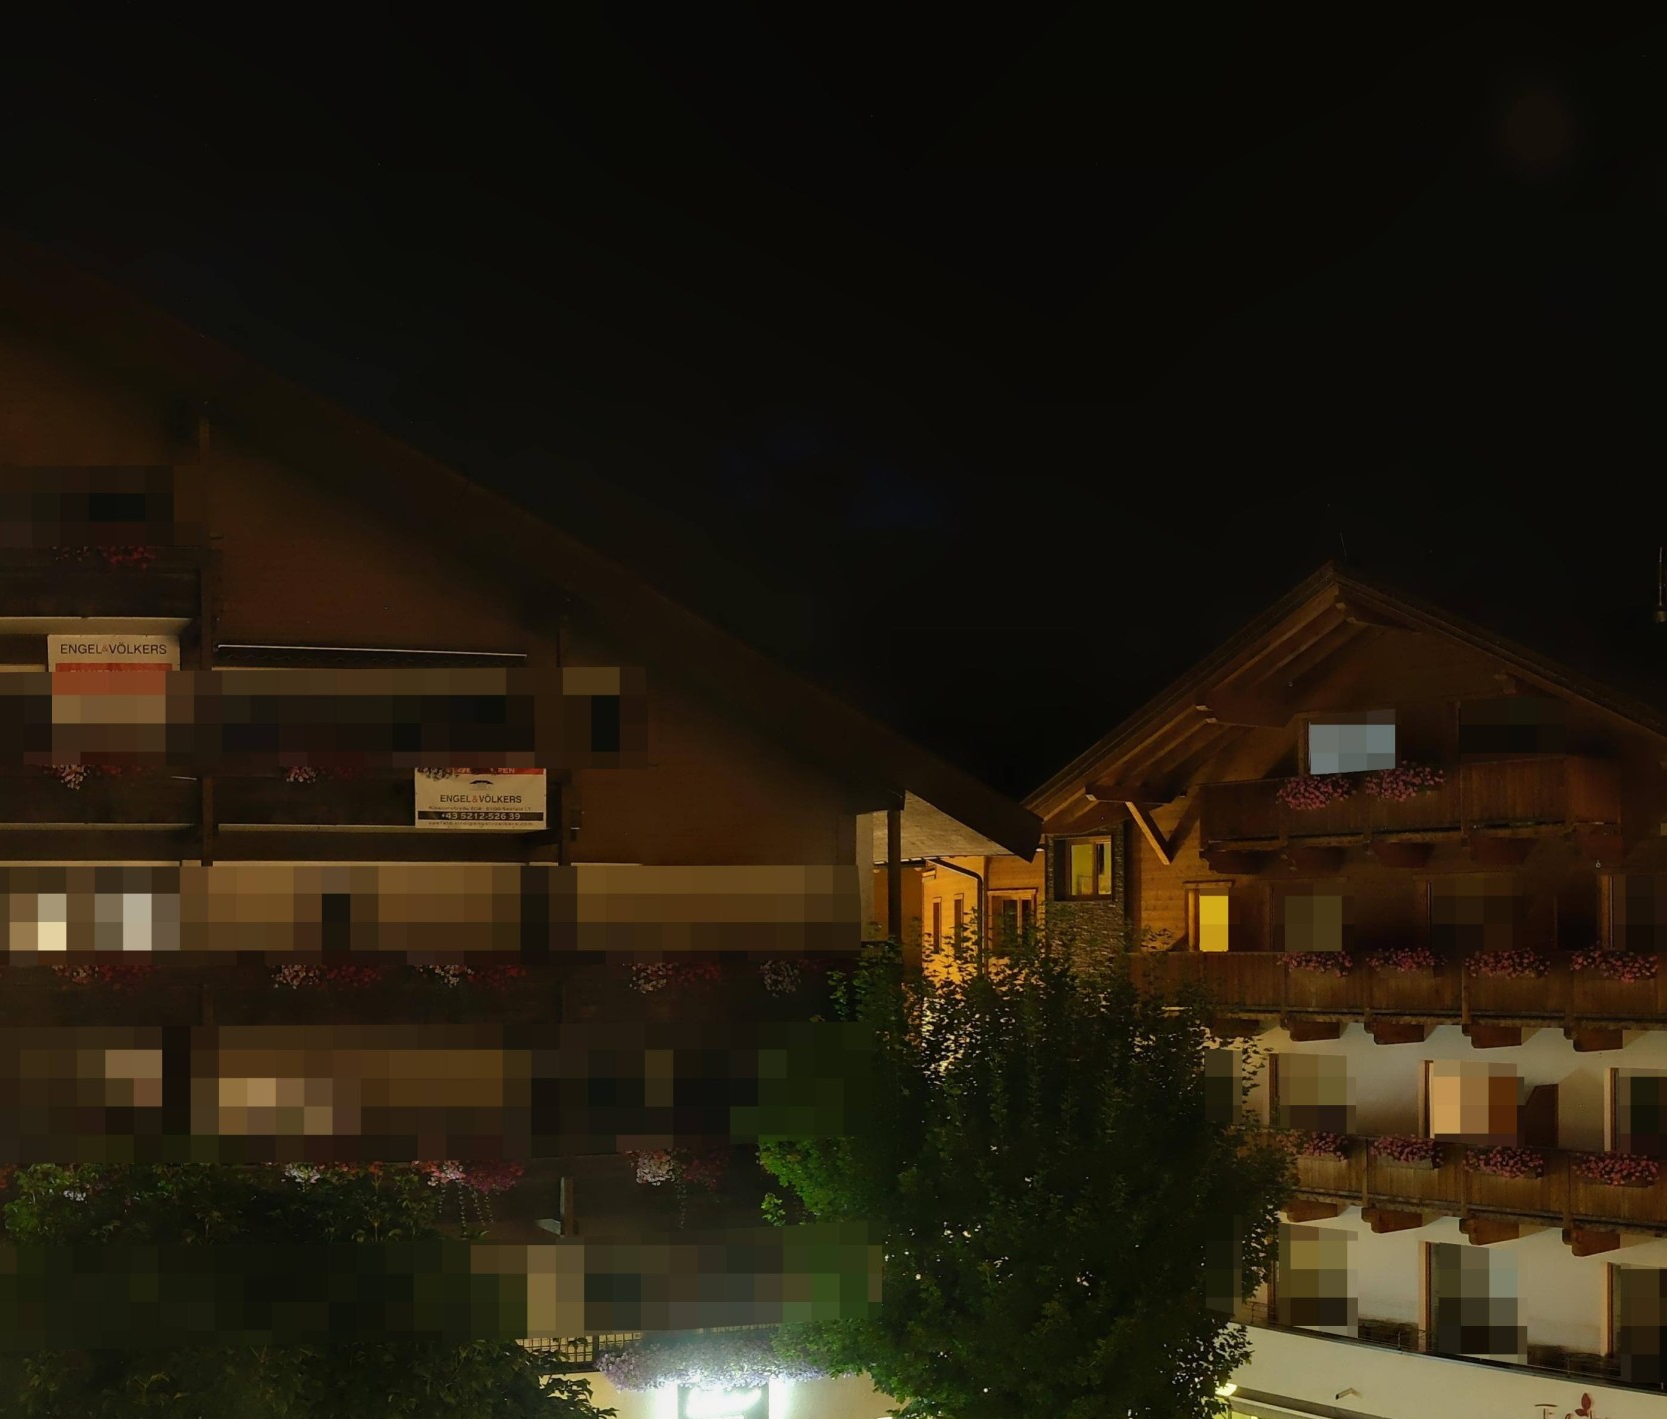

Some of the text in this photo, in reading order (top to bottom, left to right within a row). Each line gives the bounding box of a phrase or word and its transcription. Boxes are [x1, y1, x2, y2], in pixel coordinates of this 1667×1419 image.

[60, 642, 167, 655] ENGEL&VÖLKERS
[440, 793, 522, 804] ENGEL&VÖLKERS
[460, 812, 507, 820] 5212-526
